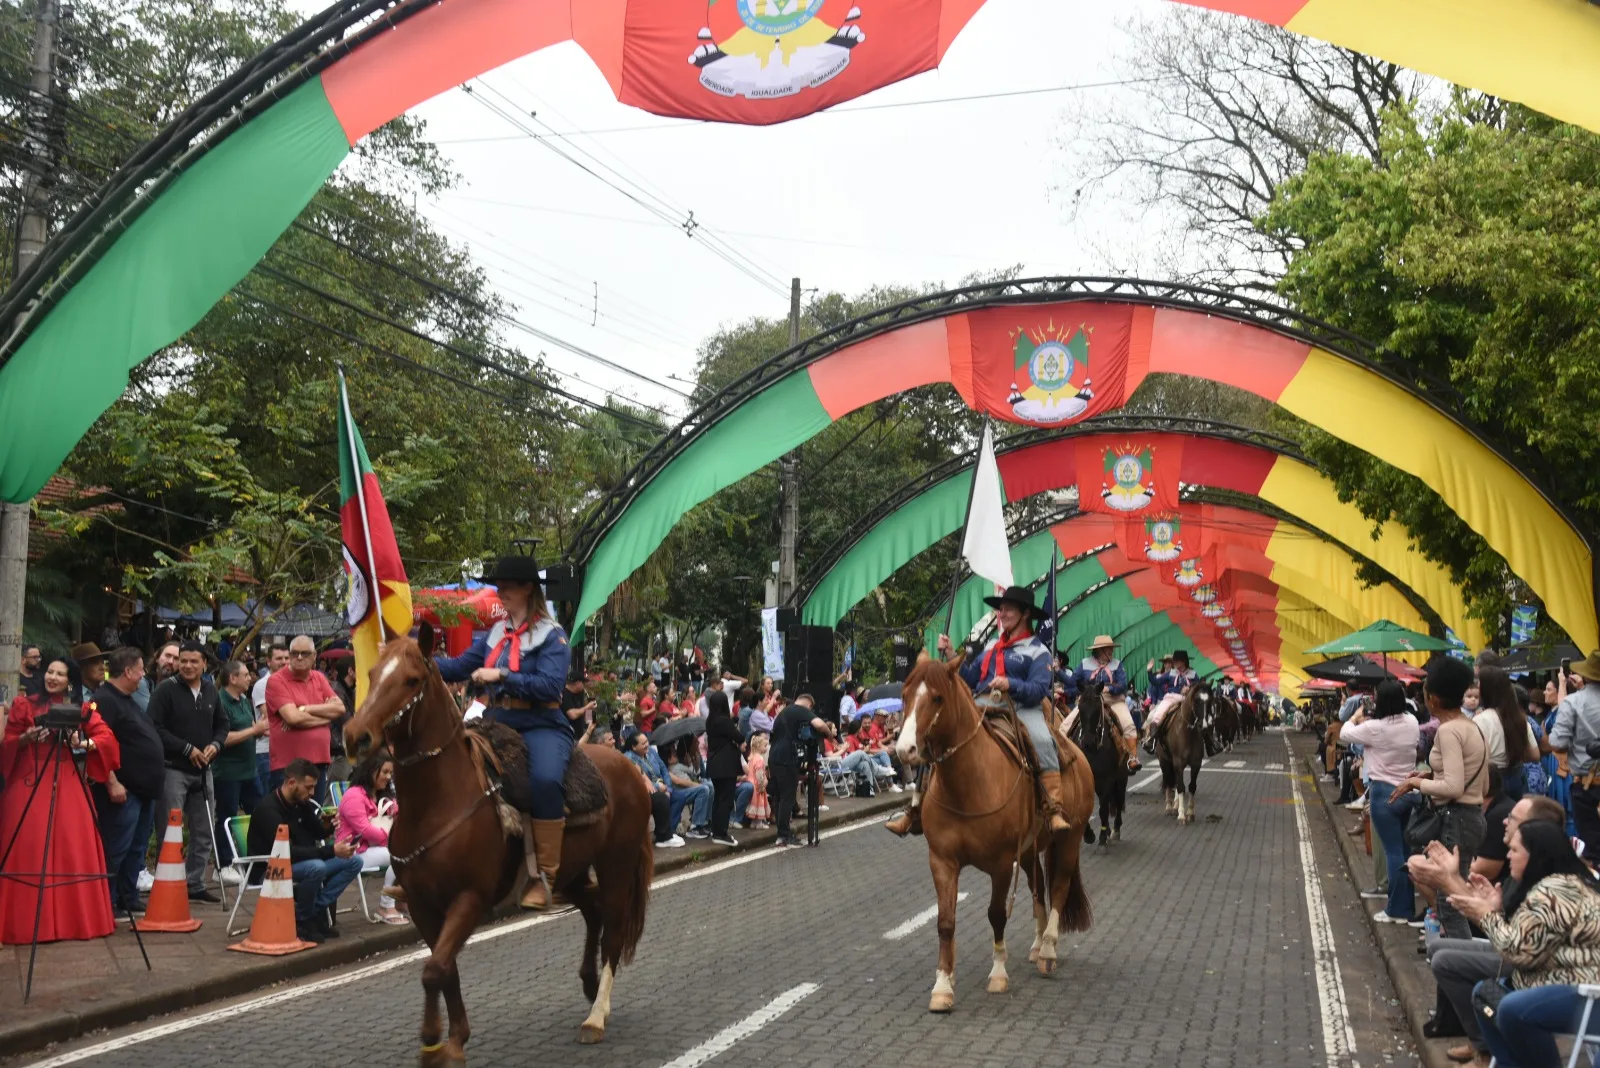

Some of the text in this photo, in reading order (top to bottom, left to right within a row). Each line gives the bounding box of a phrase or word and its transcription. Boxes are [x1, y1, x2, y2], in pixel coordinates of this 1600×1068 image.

[701, 57, 848, 96] LIBERDADE IGUALDADE HUMANIDADE
